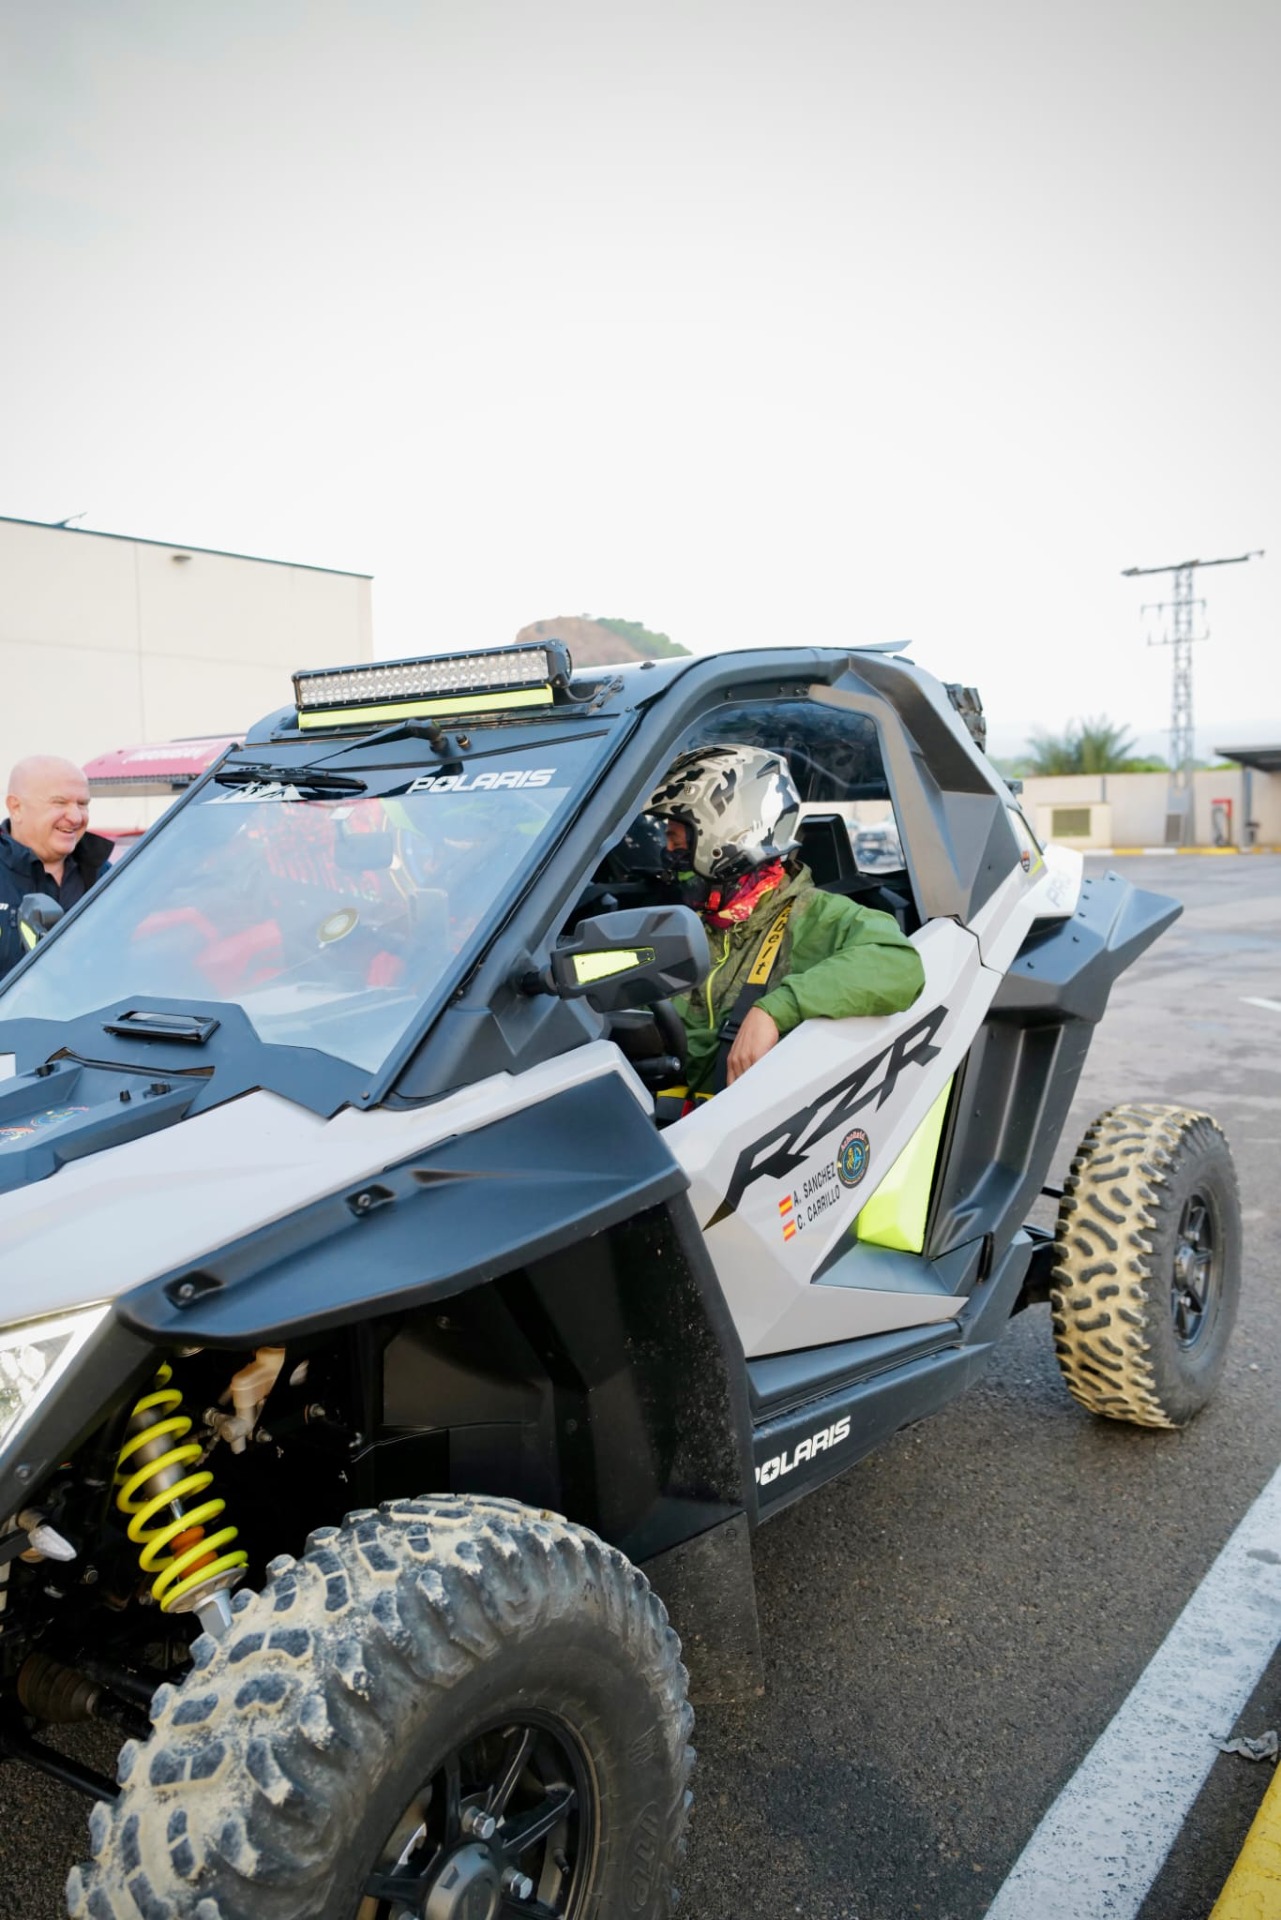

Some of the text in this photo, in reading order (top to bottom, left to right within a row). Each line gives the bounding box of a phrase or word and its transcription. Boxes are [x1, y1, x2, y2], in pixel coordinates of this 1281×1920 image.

[405, 768, 557, 795] POLARIS
[702, 1004, 949, 1232] RZR
[793, 1162, 836, 1207] A. SANCHEZ
[797, 1184, 840, 1230] C. CARRILLO
